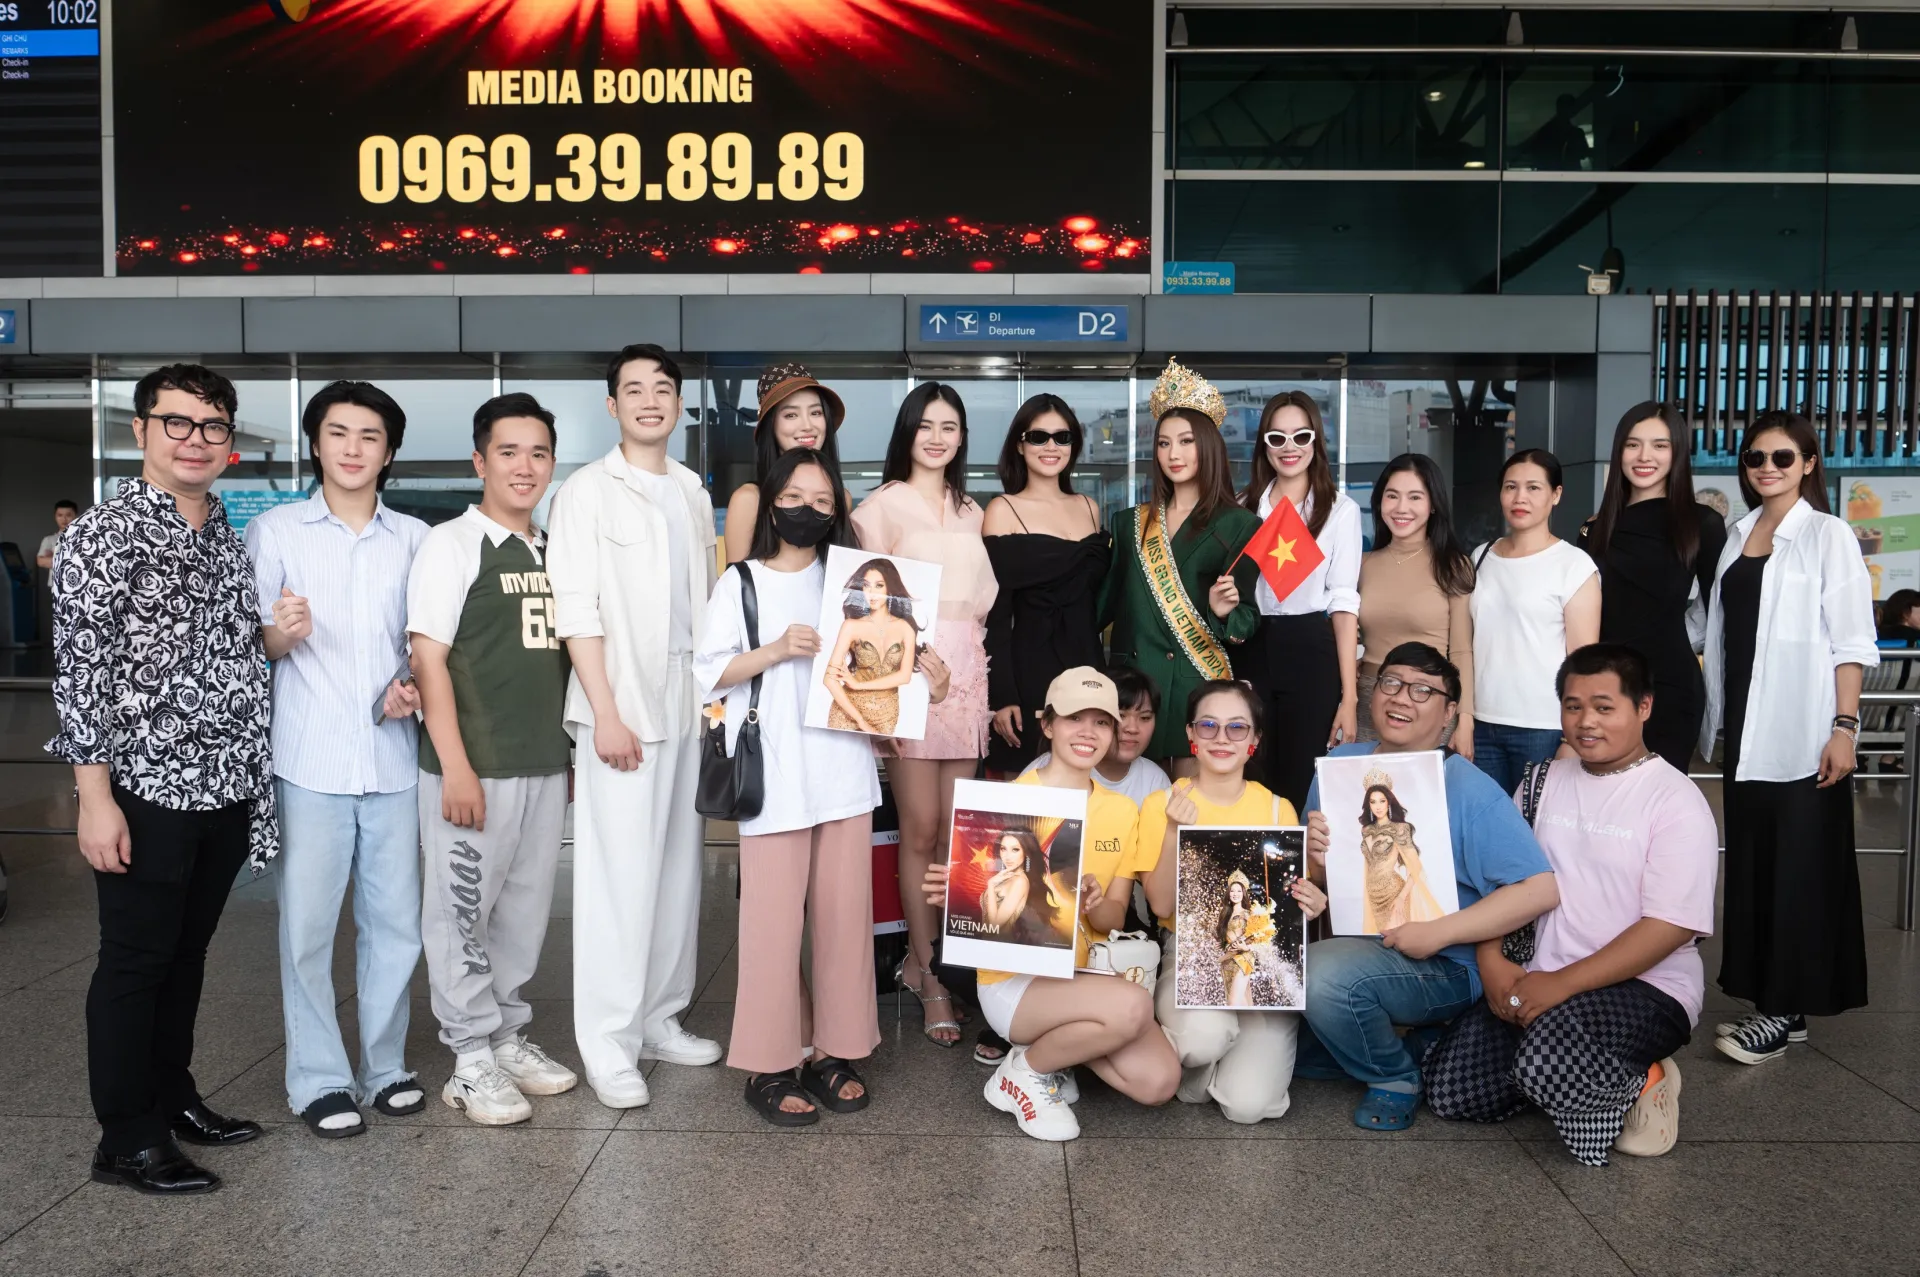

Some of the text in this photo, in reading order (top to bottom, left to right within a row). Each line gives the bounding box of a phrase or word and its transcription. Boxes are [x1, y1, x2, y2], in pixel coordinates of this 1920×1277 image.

[47, 0, 97, 24] 10:02
[2, 34, 13, 42] GHI
[2, 47, 29, 55] REMARKS
[2, 58, 29, 67] Check-in
[2, 70, 29, 79] Check-in
[467, 67, 753, 105] MEDIA BOOKING
[359, 131, 865, 204] 0969.39.89.89
[1166, 276, 1231, 286] 0933.33.99.88
[989, 312, 1001, 322] ĐI
[1078, 312, 1116, 336] D2
[988, 326, 1036, 336] Departure
[1146, 535, 1225, 678] MISS GRAND VIETNAM 2024
[950, 919, 1000, 934] VIETNAM
[1000, 1076, 1037, 1122] BOSTON
